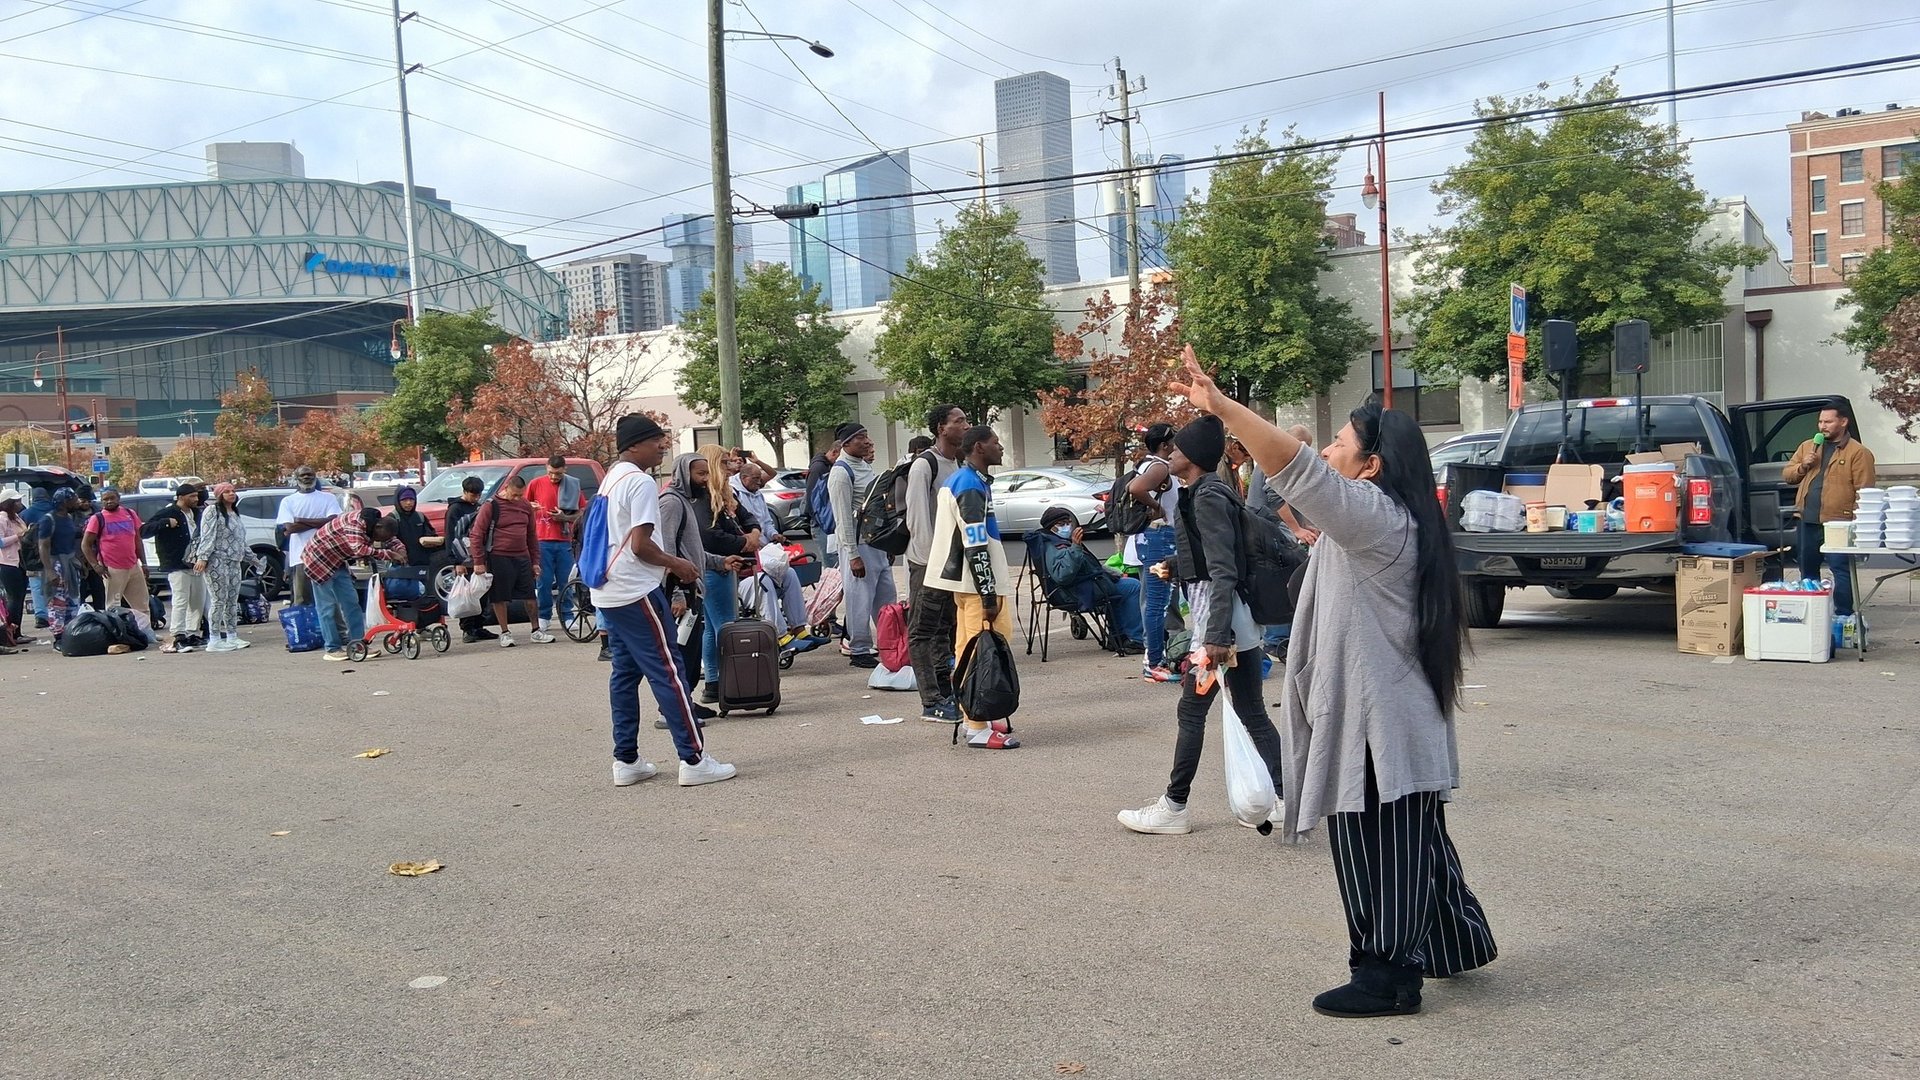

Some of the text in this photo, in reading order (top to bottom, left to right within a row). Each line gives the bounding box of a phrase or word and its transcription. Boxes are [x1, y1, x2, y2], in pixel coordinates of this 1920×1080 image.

[1514, 301, 1523, 326] 10
[966, 525, 987, 544] 90
[973, 553, 989, 595] TEAM
